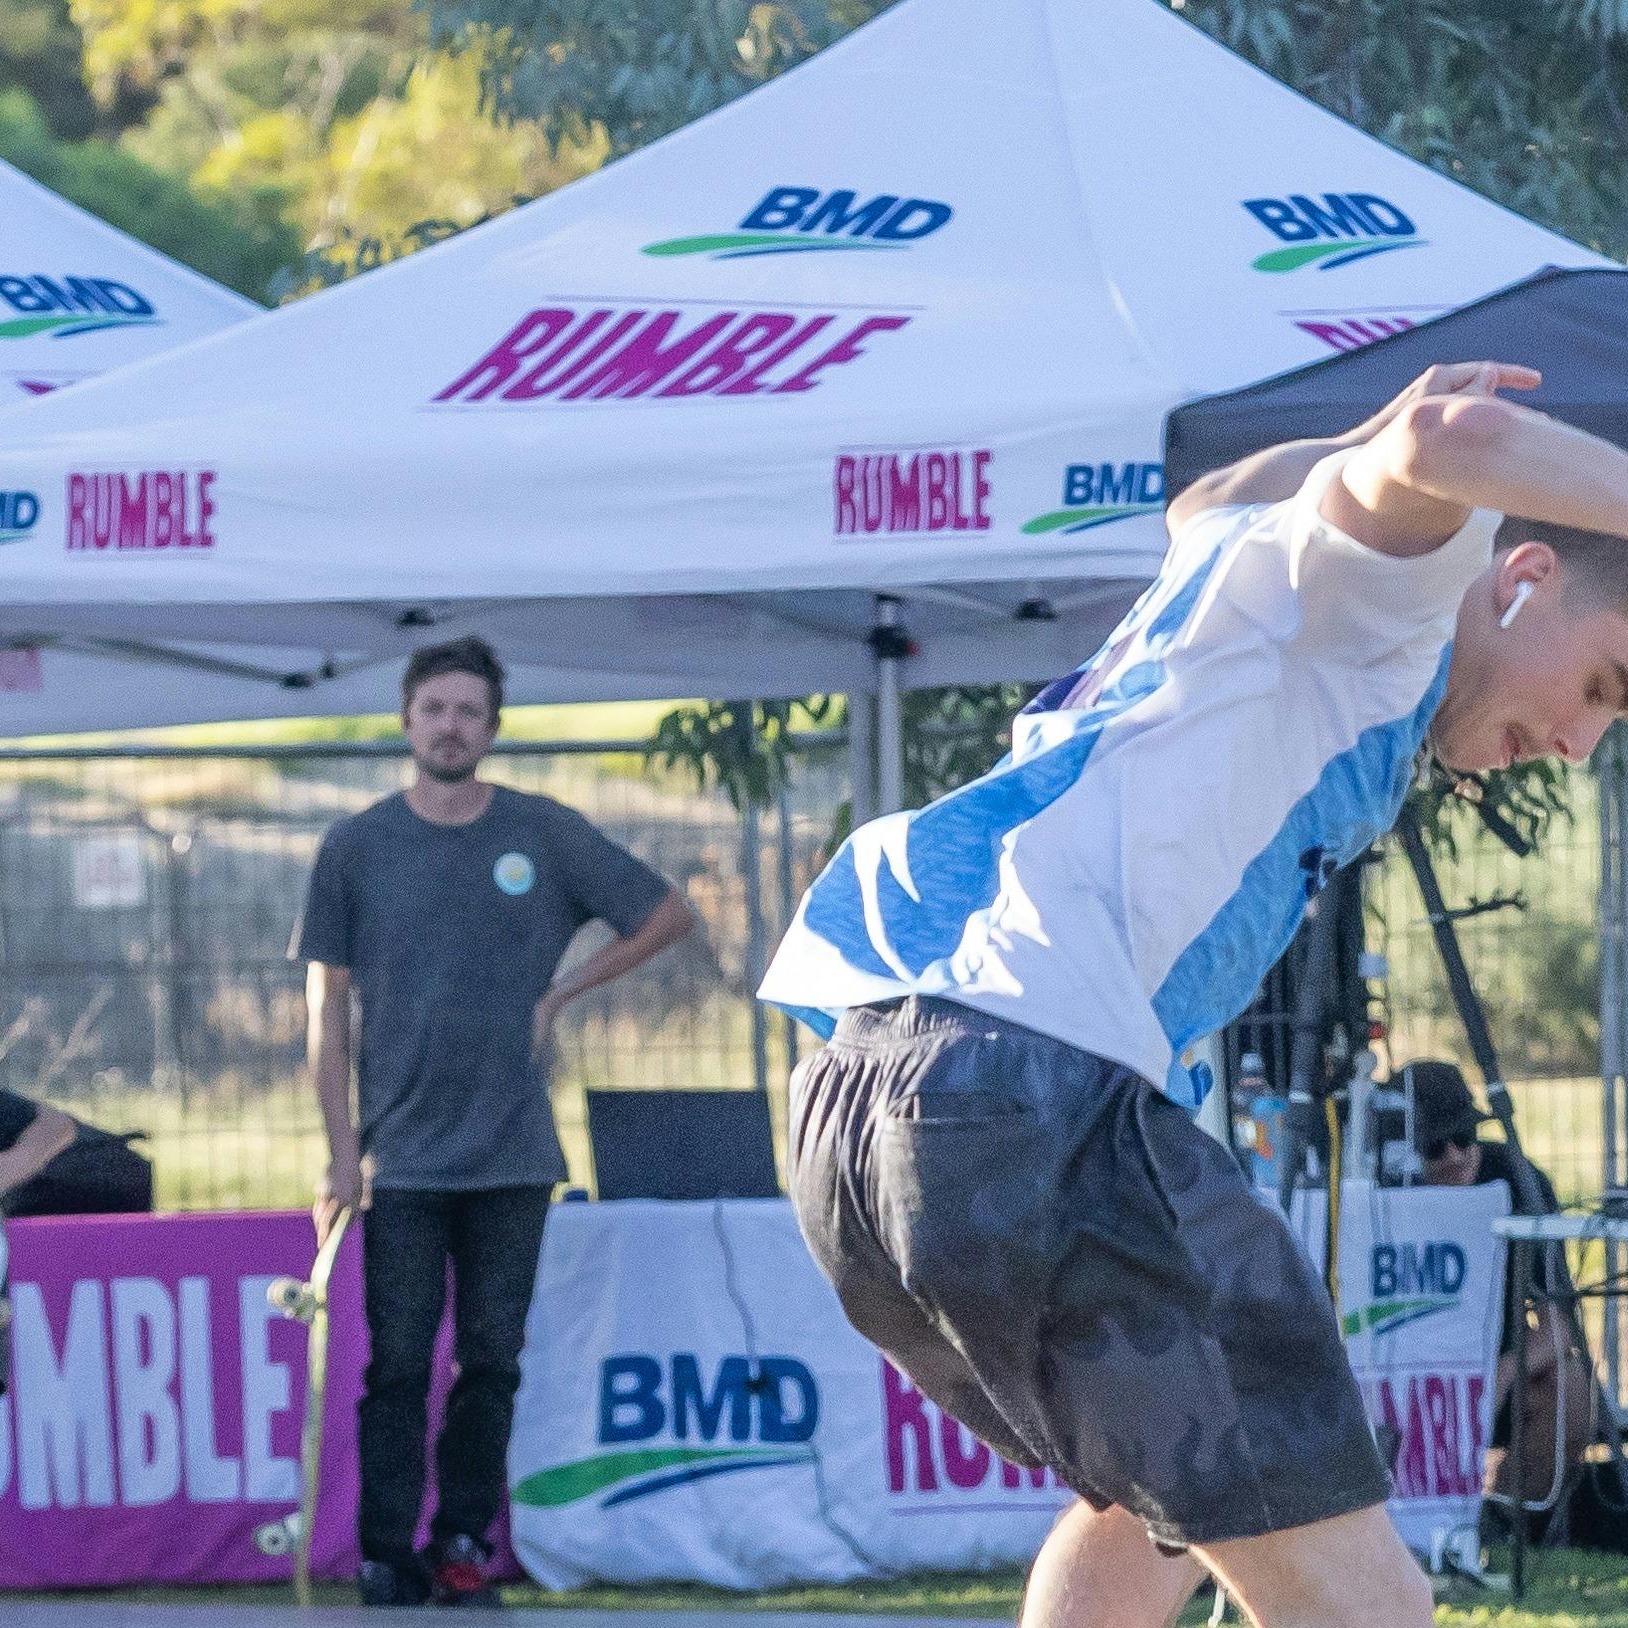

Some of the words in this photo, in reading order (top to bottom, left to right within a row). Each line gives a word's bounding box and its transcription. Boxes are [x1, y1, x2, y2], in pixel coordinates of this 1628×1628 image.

[738, 186, 953, 241] BMD
[1242, 192, 1416, 242] BMD
[430, 308, 912, 401] RUMBLE
[65, 471, 217, 550] RUMBLE
[834, 450, 992, 534] RUMBLE
[1064, 462, 1165, 505] BMD
[1371, 1240, 1465, 1297] BMD
[599, 1352, 819, 1444] BMD
